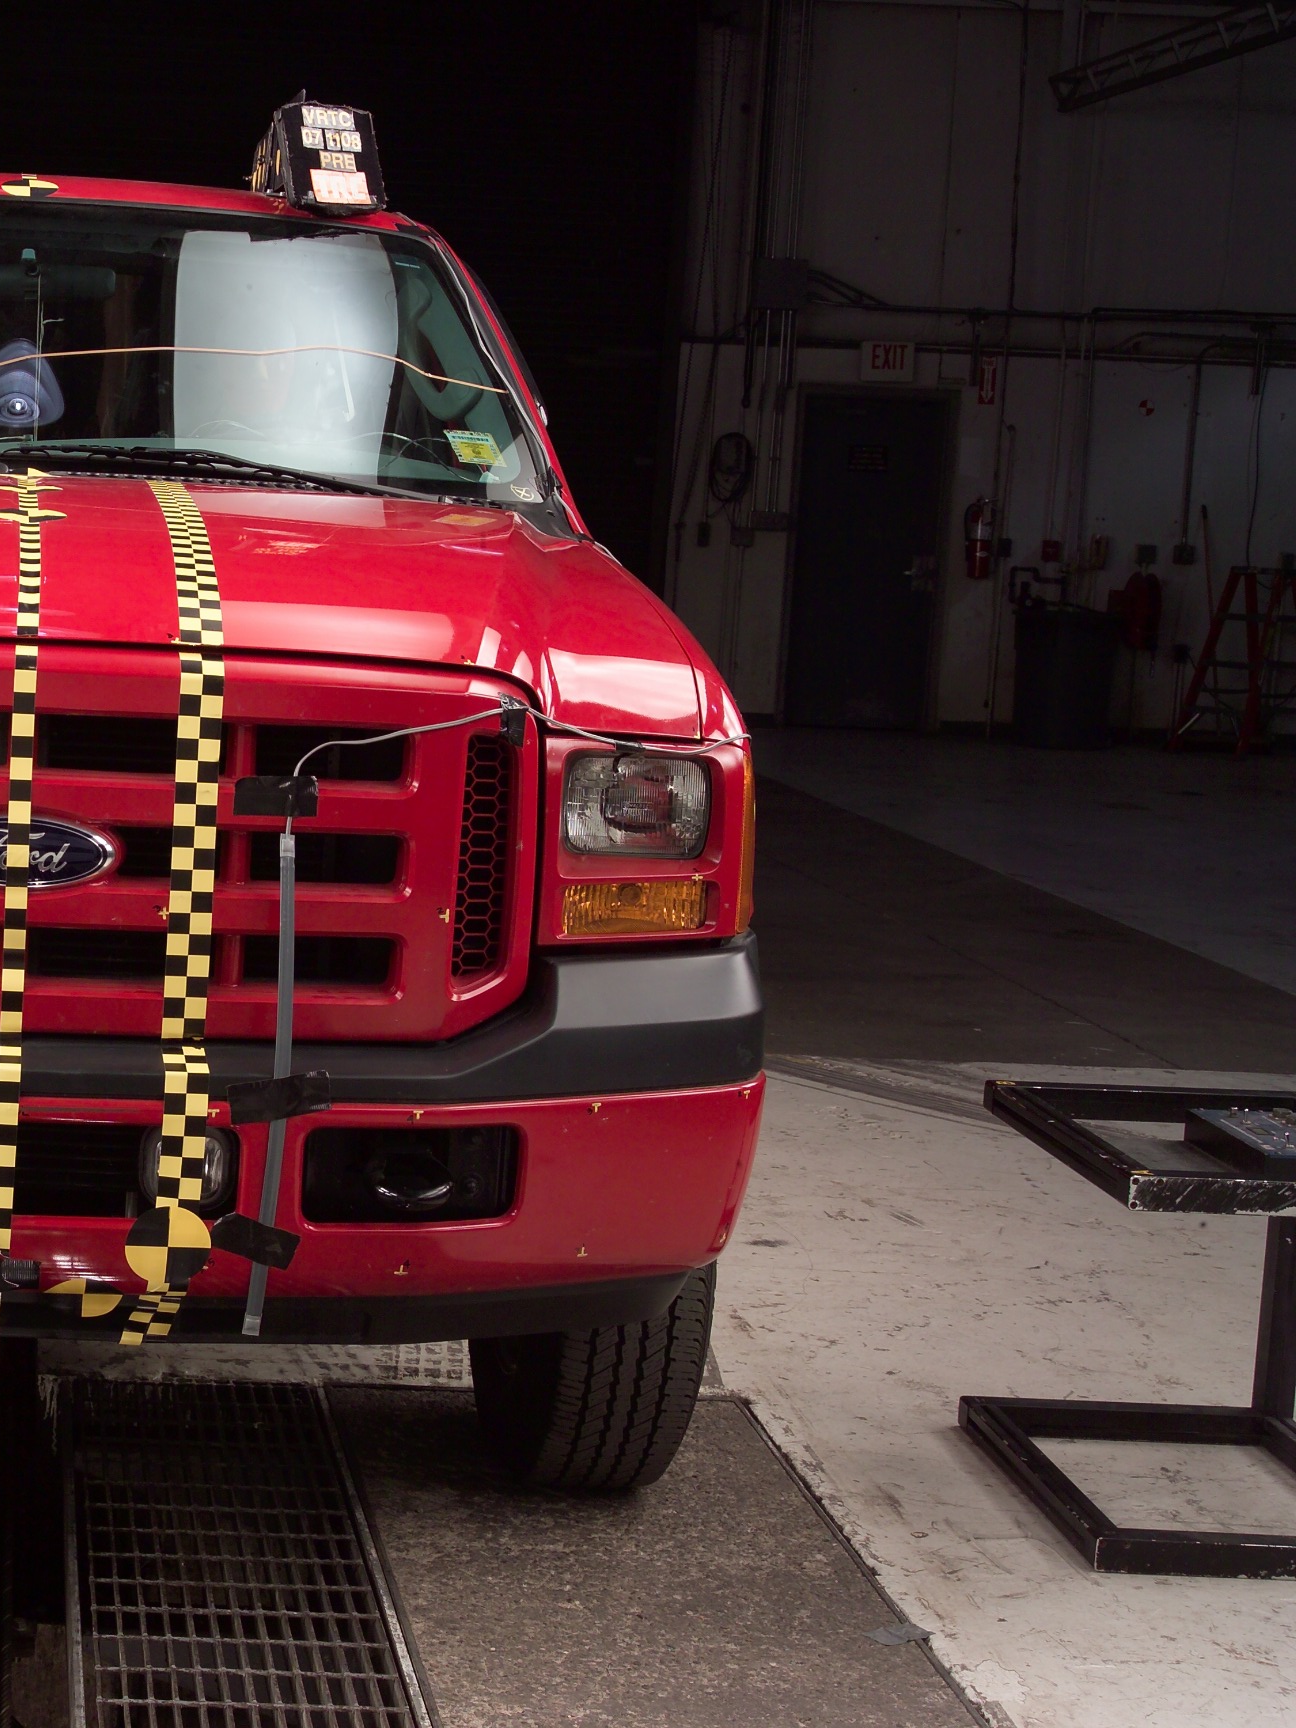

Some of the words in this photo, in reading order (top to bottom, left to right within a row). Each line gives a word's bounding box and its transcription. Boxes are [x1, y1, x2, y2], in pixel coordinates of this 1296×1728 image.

[303, 108, 352, 127] VRTC
[320, 153, 355, 169] PRE
[871, 344, 908, 370] EXIT
